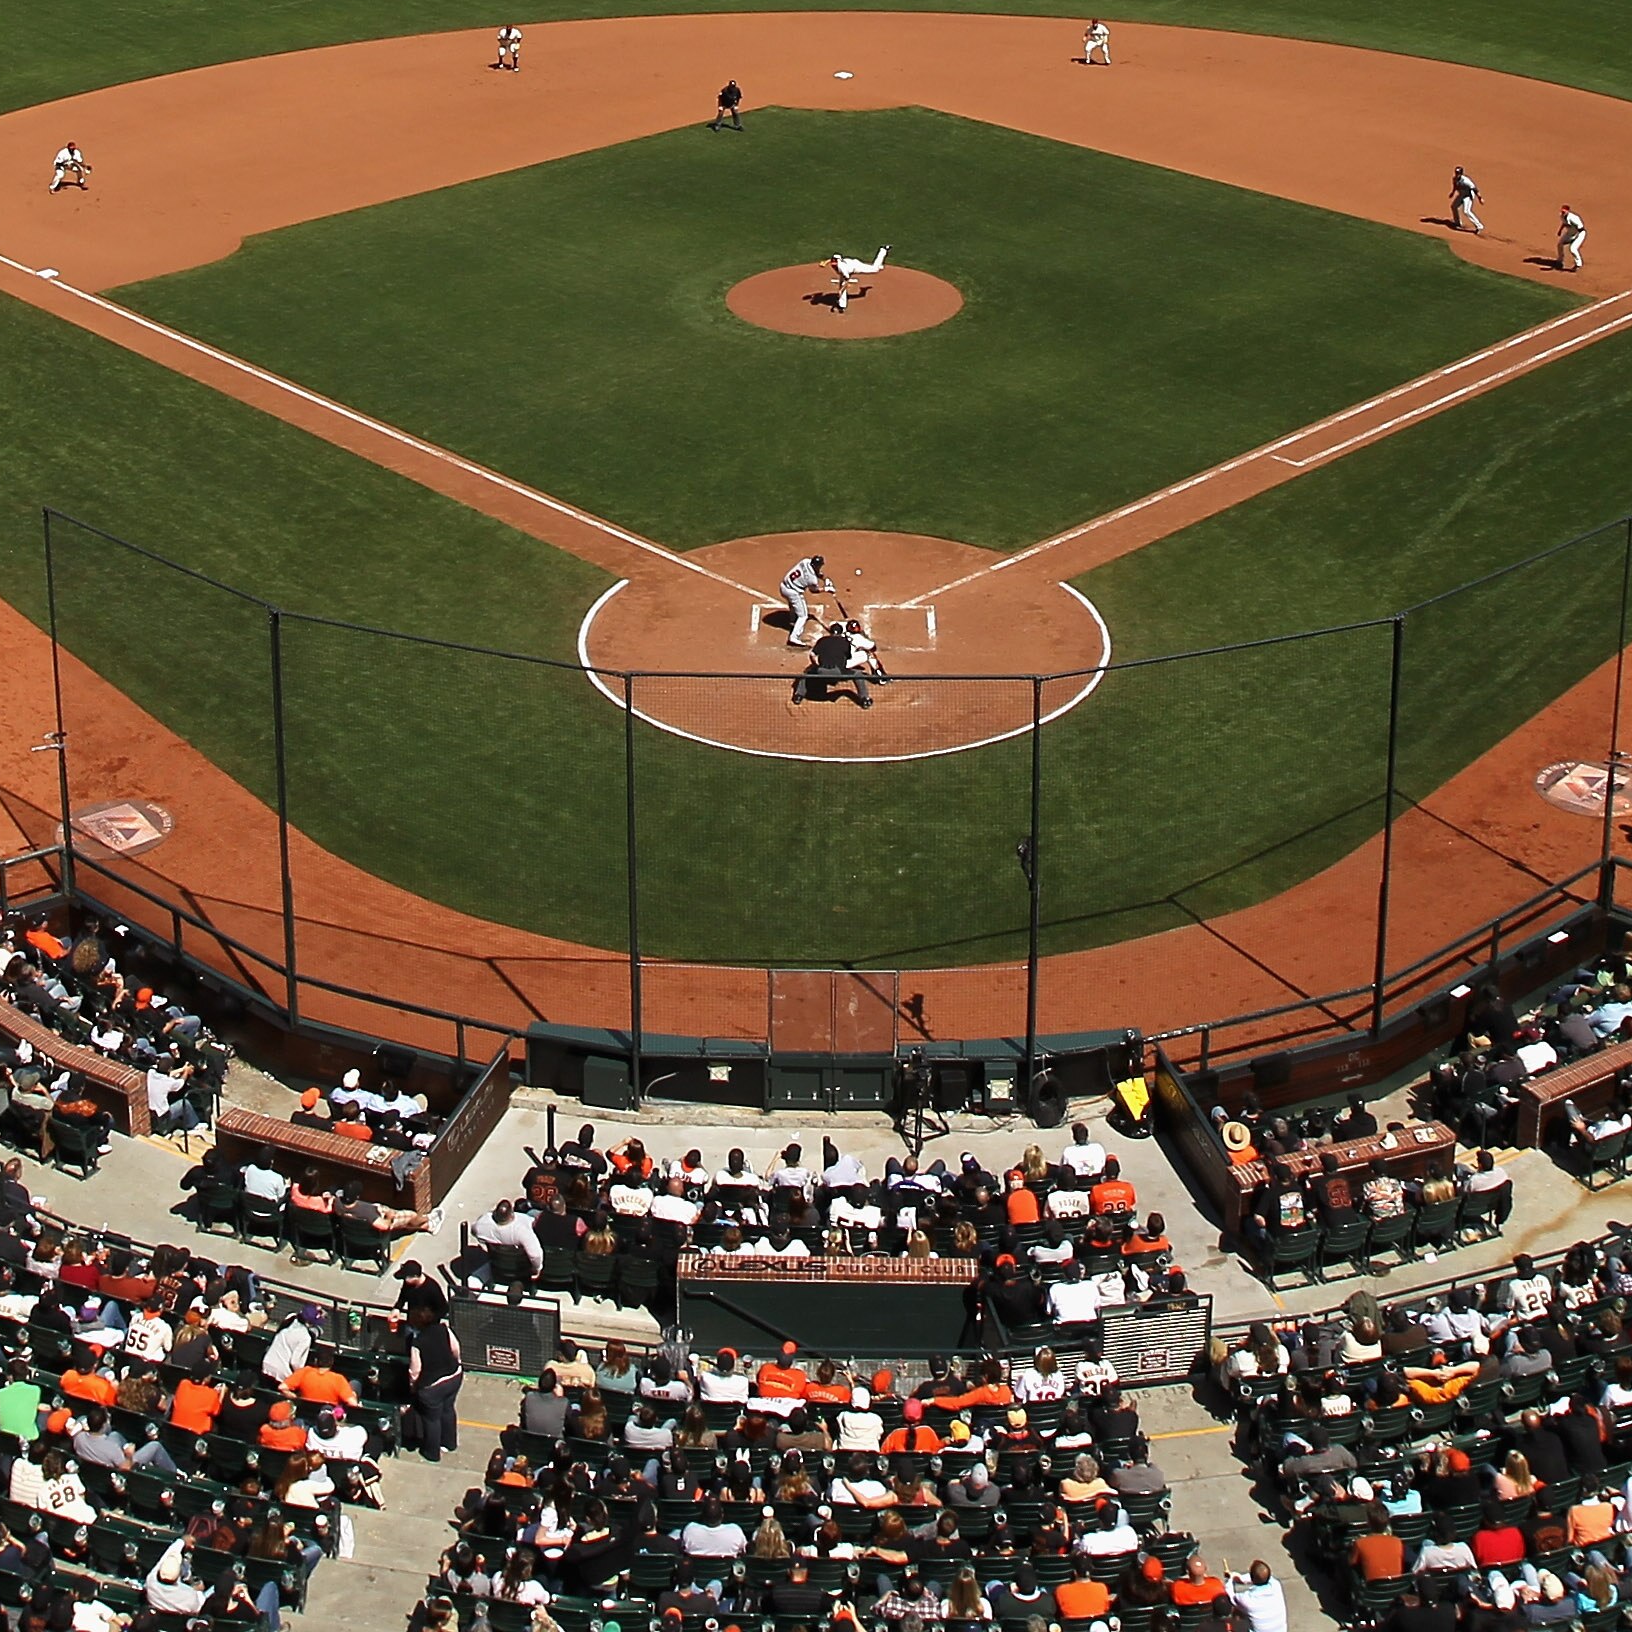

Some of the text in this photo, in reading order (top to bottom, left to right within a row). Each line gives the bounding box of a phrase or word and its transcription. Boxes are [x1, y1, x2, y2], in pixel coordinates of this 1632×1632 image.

[789, 568, 803, 579] 2
[718, 1258, 828, 1271] LEXUS
[918, 1264, 967, 1276] CLUB
[1527, 1291, 1549, 1311] 28
[127, 1329, 150, 1352] 55
[49, 1485, 75, 1509] 28
